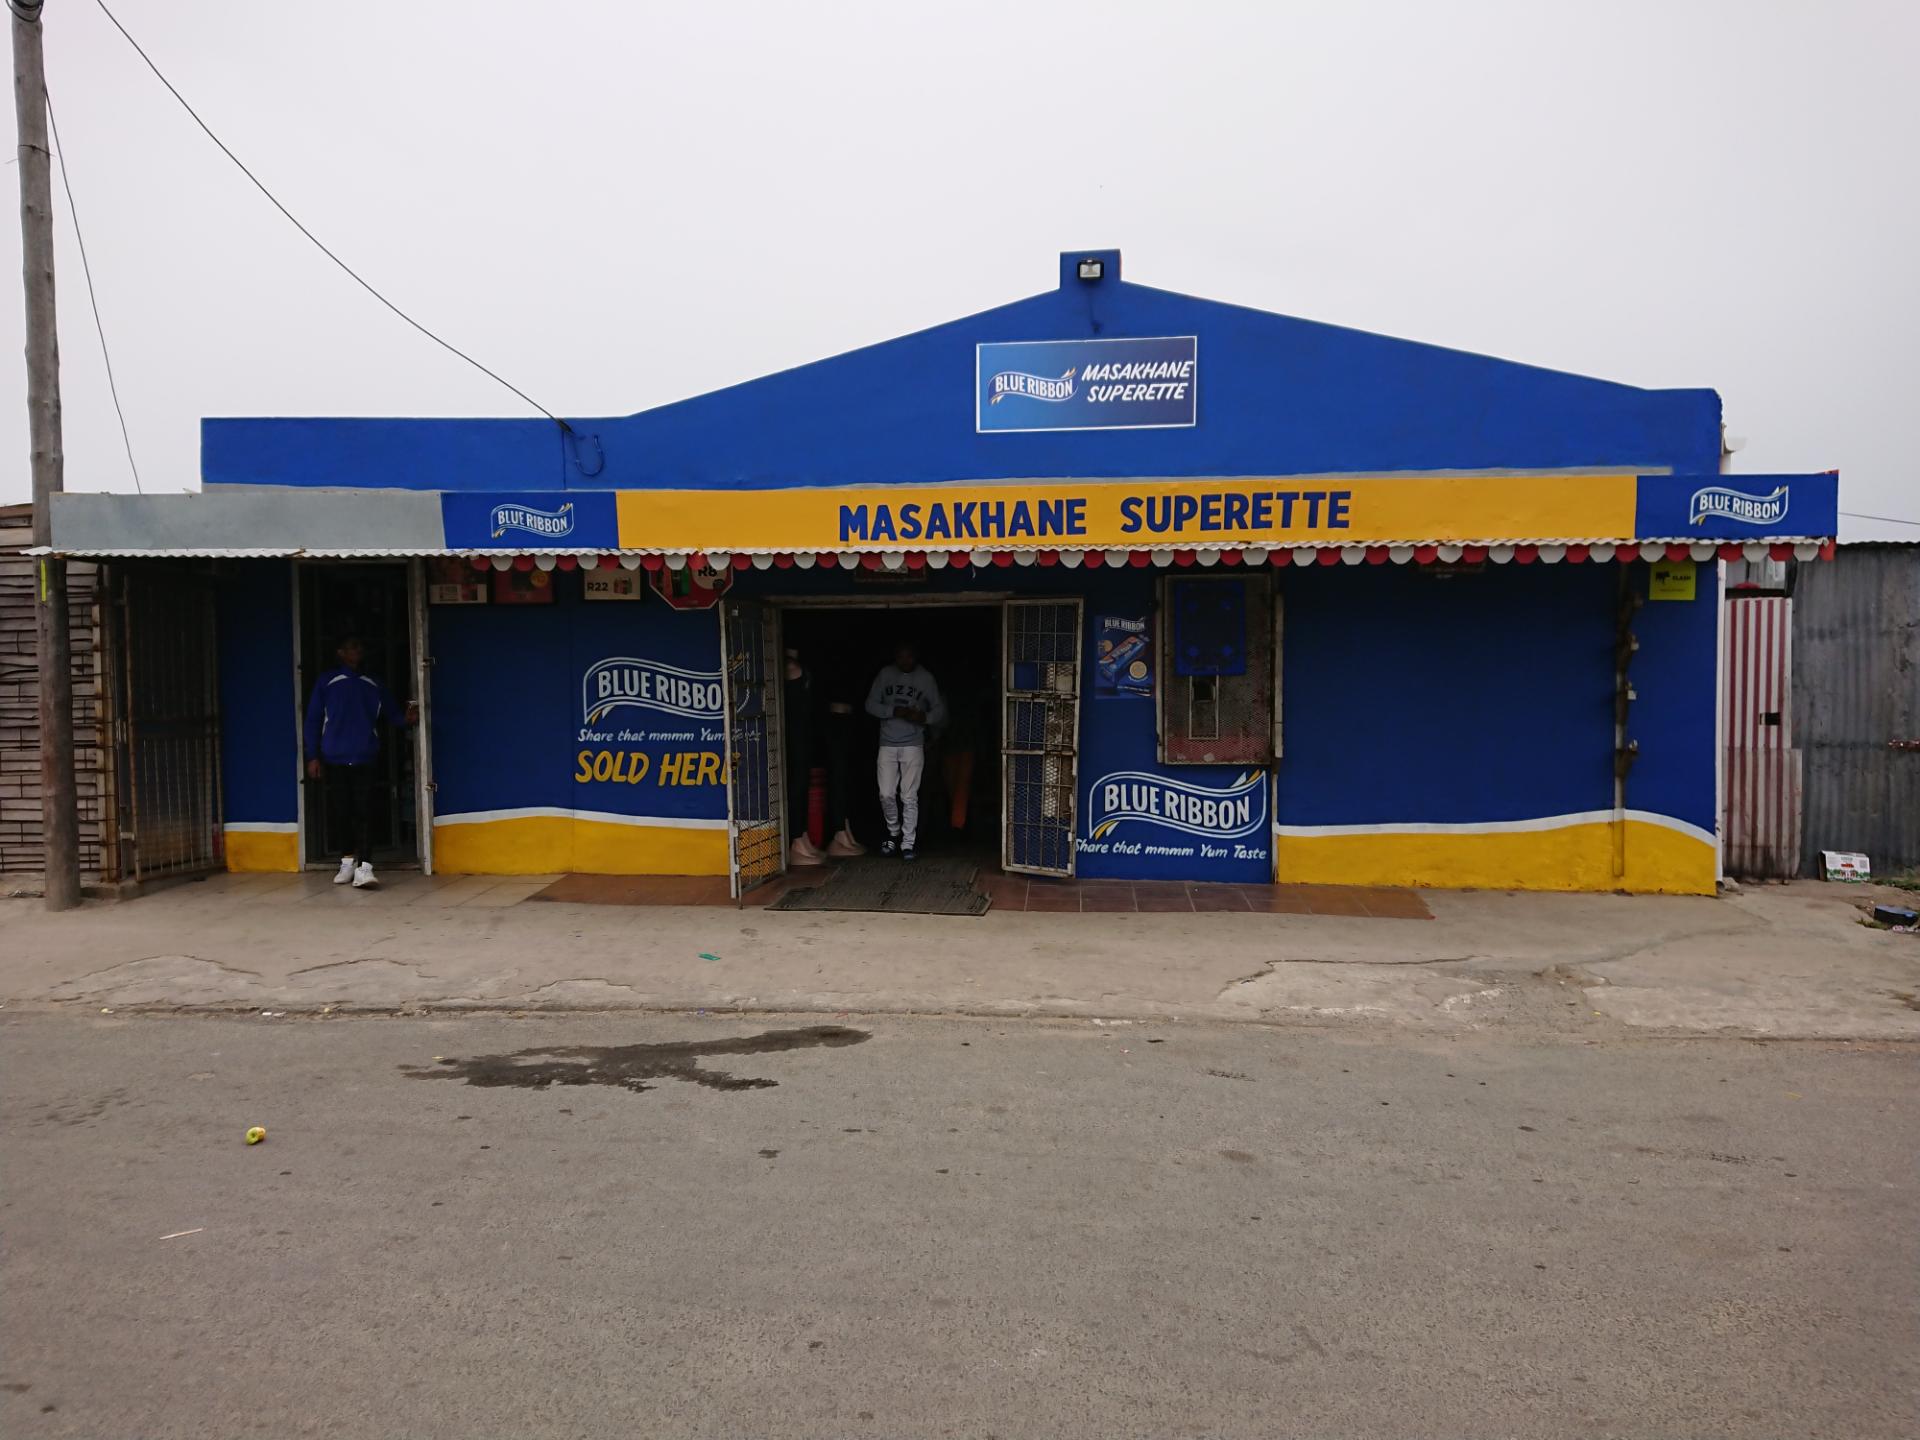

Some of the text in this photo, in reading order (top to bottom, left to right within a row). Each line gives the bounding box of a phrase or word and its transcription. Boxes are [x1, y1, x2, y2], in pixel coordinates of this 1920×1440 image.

[1081, 360, 1194, 381] MASAKHANE
[995, 375, 1073, 398] BLUE RIBBON
[1087, 382, 1188, 402] SUPERETTE
[839, 491, 1351, 542] MASAKHANE SUPERETTE
[1699, 494, 1780, 519] BLUE RIBBON
[497, 510, 568, 532] BLUE RIBBON
[587, 582, 609, 592] R22
[598, 668, 723, 710] BLUE RIBBO
[577, 728, 614, 742] Share
[617, 728, 646, 742] that
[648, 732, 695, 742] mmmm
[575, 749, 650, 785] SOLD
[1104, 783, 1250, 830] BLUE RIBBON
[1075, 838, 1267, 860] Share that mmmm Yum Taste
